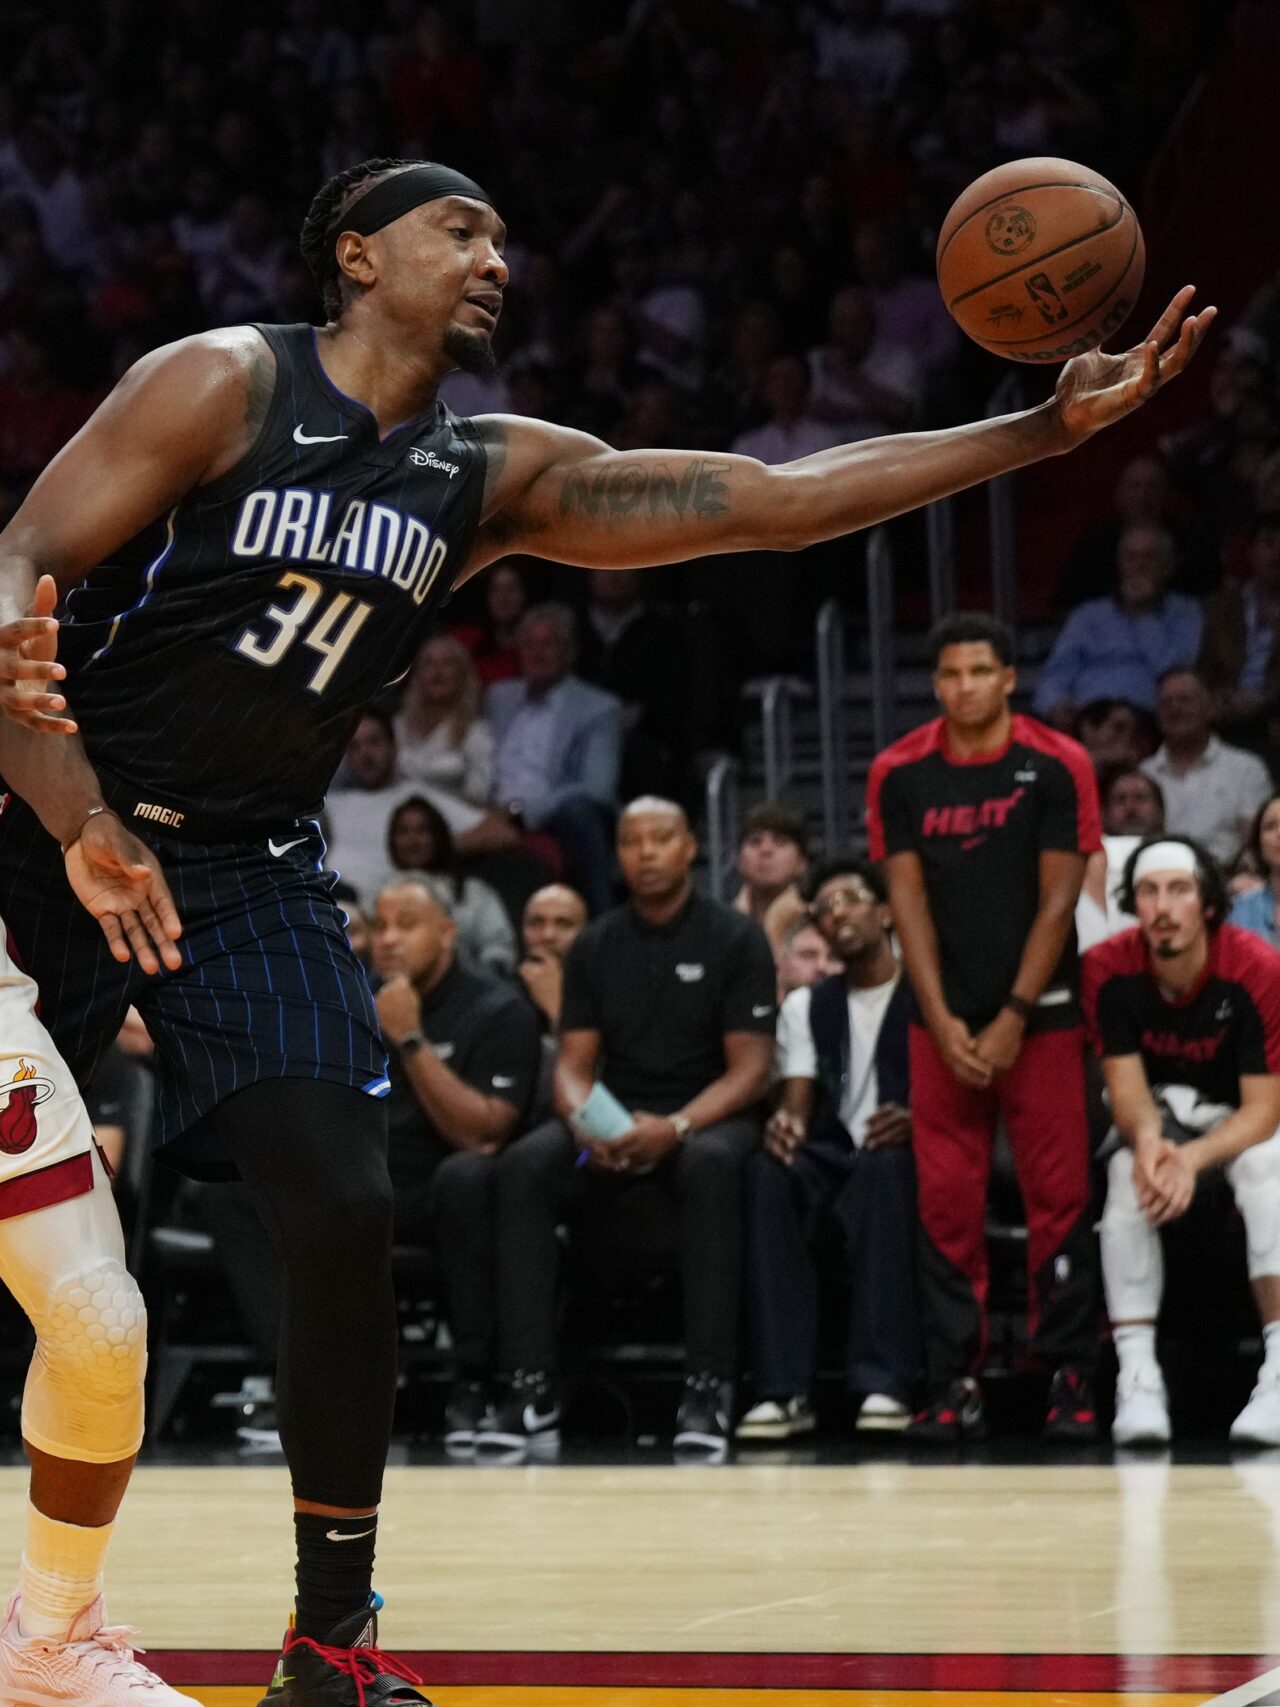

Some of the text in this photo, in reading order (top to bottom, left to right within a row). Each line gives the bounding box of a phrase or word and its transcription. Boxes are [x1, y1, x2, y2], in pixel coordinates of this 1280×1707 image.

[410, 446, 460, 479] Disney
[233, 490, 447, 605] ORLANDO
[235, 570, 374, 694] 34
[133, 802, 185, 828] MAGIC
[922, 787, 1025, 836] HEAT
